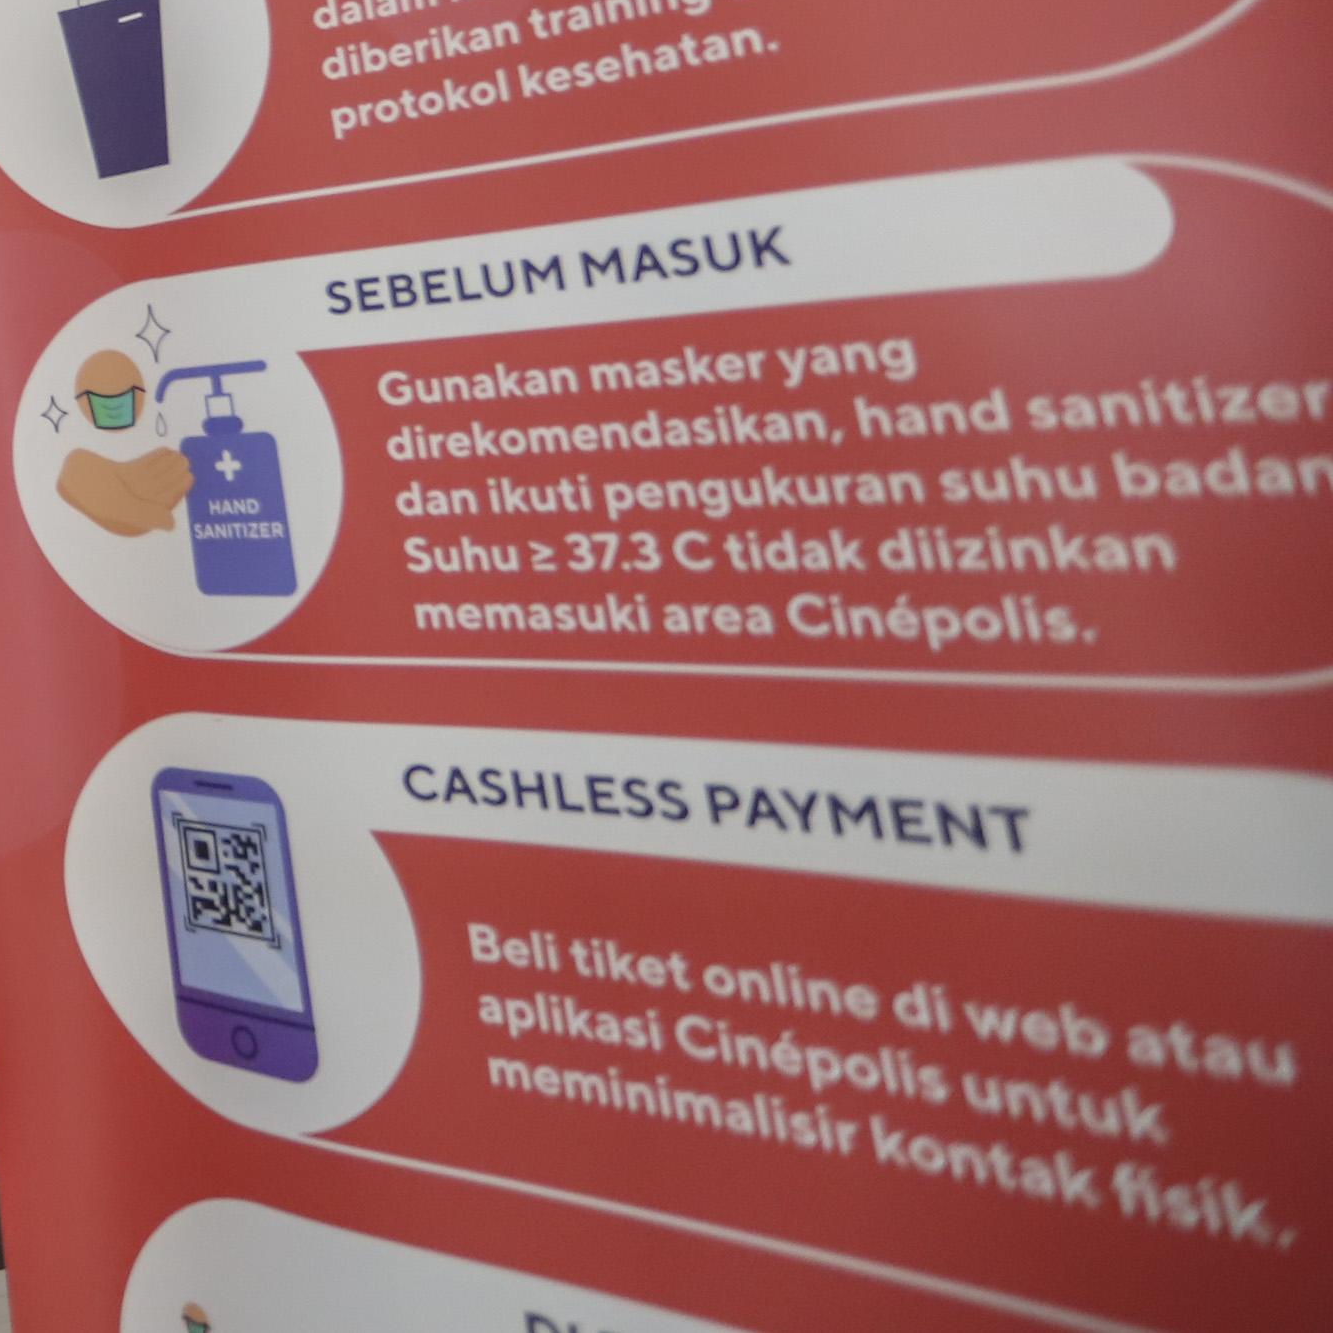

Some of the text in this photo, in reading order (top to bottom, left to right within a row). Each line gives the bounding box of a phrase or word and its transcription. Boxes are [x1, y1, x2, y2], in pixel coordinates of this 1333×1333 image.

[321, 16, 520, 79] diberikan
[330, 26, 781, 139] protokol kesehatan.
[326, 225, 792, 316] SEBELUM MASUK
[378, 337, 917, 406] Gunakan masker yang
[387, 376, 1331, 462] direkomendasikan, hand sanitizer
[208, 498, 260, 515] HAND
[395, 447, 1333, 521] dan ikuti pengukuran suhu badan
[194, 522, 284, 539] SANITIZER
[404, 538, 520, 574] Suhu
[567, 535, 660, 573] 37.3
[672, 532, 715, 572] C
[725, 529, 866, 572] tidak
[879, 524, 1177, 572] diizinkan
[414, 593, 1098, 650] memasuki area Cinépolis.
[403, 763, 1031, 853] CASHLESS PAYMENT
[467, 923, 1296, 1087] Beli tiket online di web atau
[478, 988, 1169, 1144] aplikasi Cinépolis untuk
[488, 1053, 855, 1156] meminimalisir
[870, 1117, 1100, 1209] kontak
